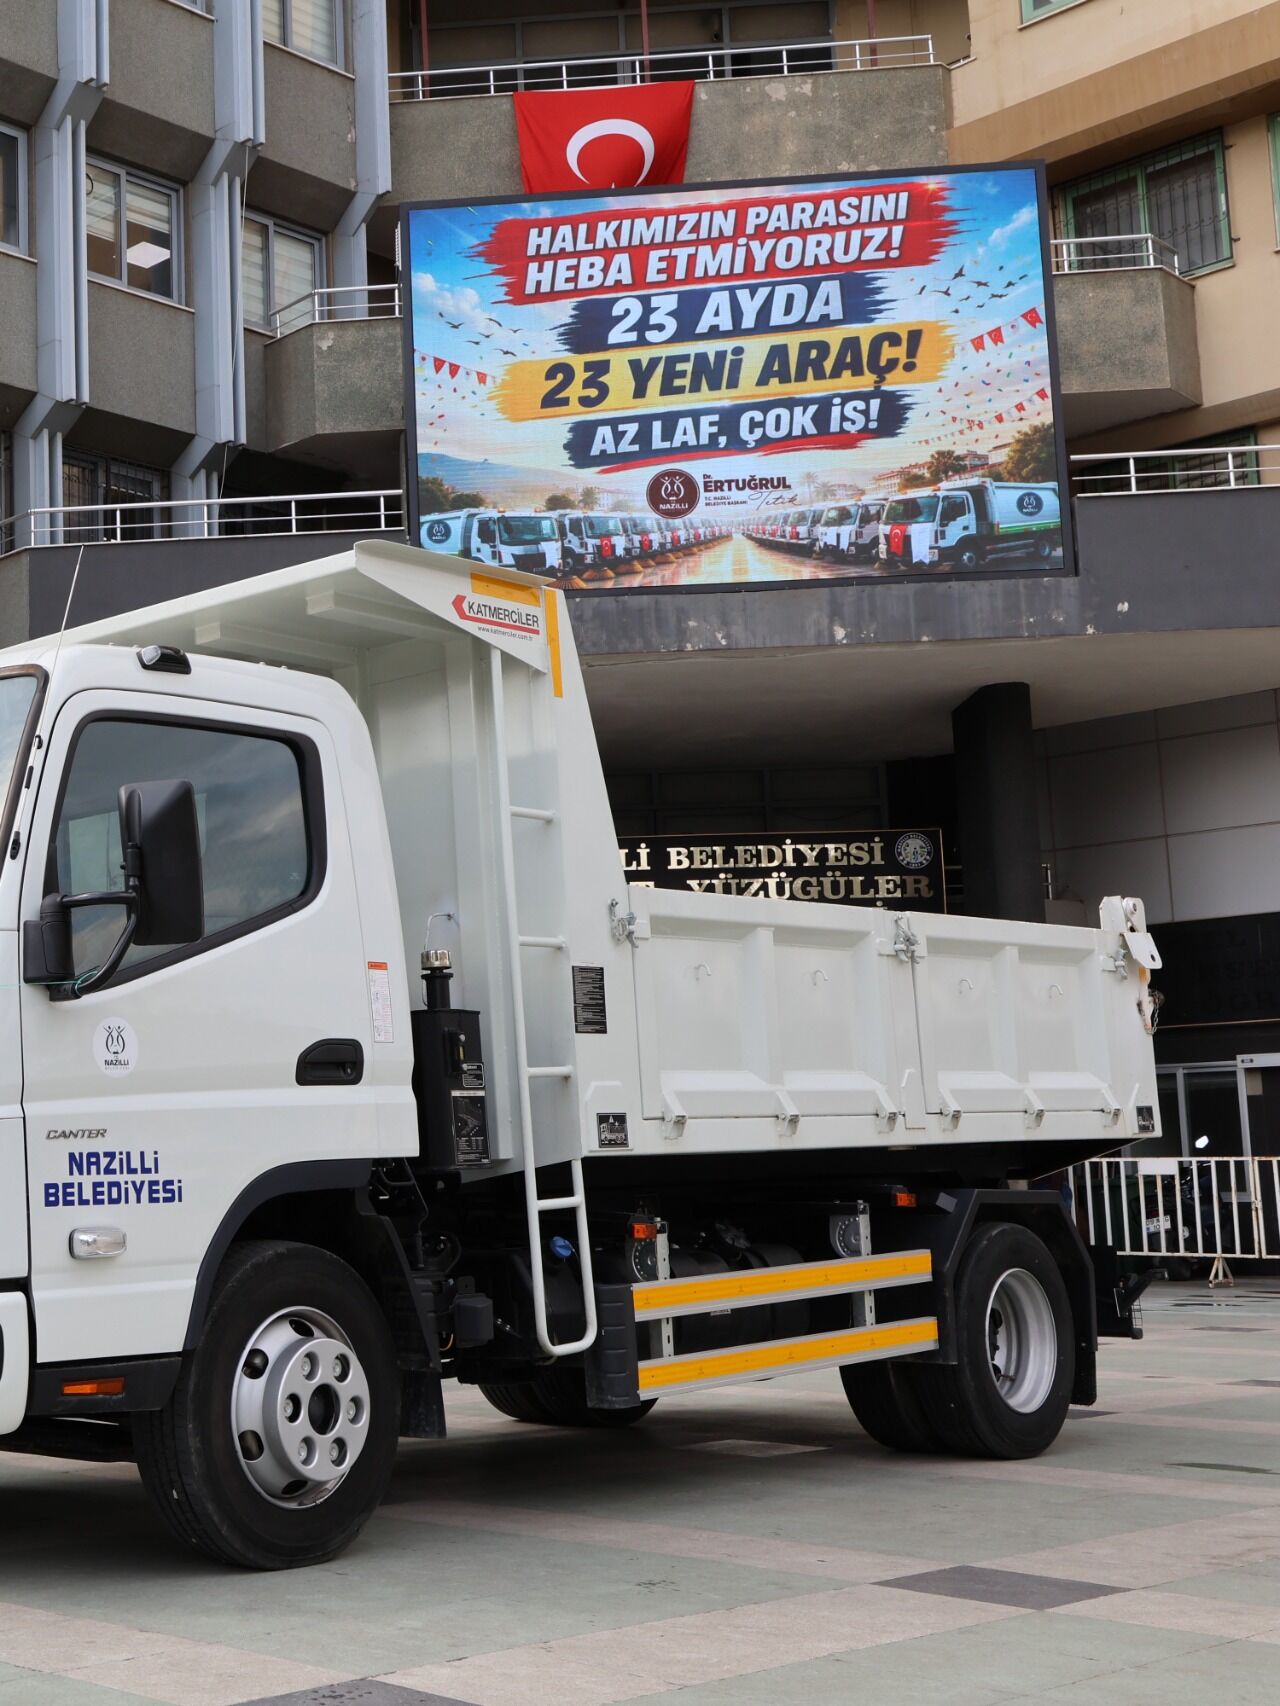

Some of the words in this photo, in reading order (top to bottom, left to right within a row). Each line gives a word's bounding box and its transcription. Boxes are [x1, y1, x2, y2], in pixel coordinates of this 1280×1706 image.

[526, 208, 737, 257] HALKIMIZIN
[745, 191, 910, 235] PARASINI
[524, 252, 634, 295] HEBA
[607, 293, 679, 345] 23
[695, 279, 844, 334] AYDA
[540, 359, 611, 410] 23
[756, 328, 923, 388] ARAÇ!
[590, 422, 639, 456] AZ
[651, 414, 728, 450] LAF,
[738, 404, 819, 449] ÇOK
[829, 397, 881, 436] İŞ!
[703, 475, 792, 493] ERTUĞRUL
[467, 600, 540, 628] KATMERCİLER
[667, 836, 885, 870] BELEDİYESİ
[46, 1128, 107, 1140] CANTER
